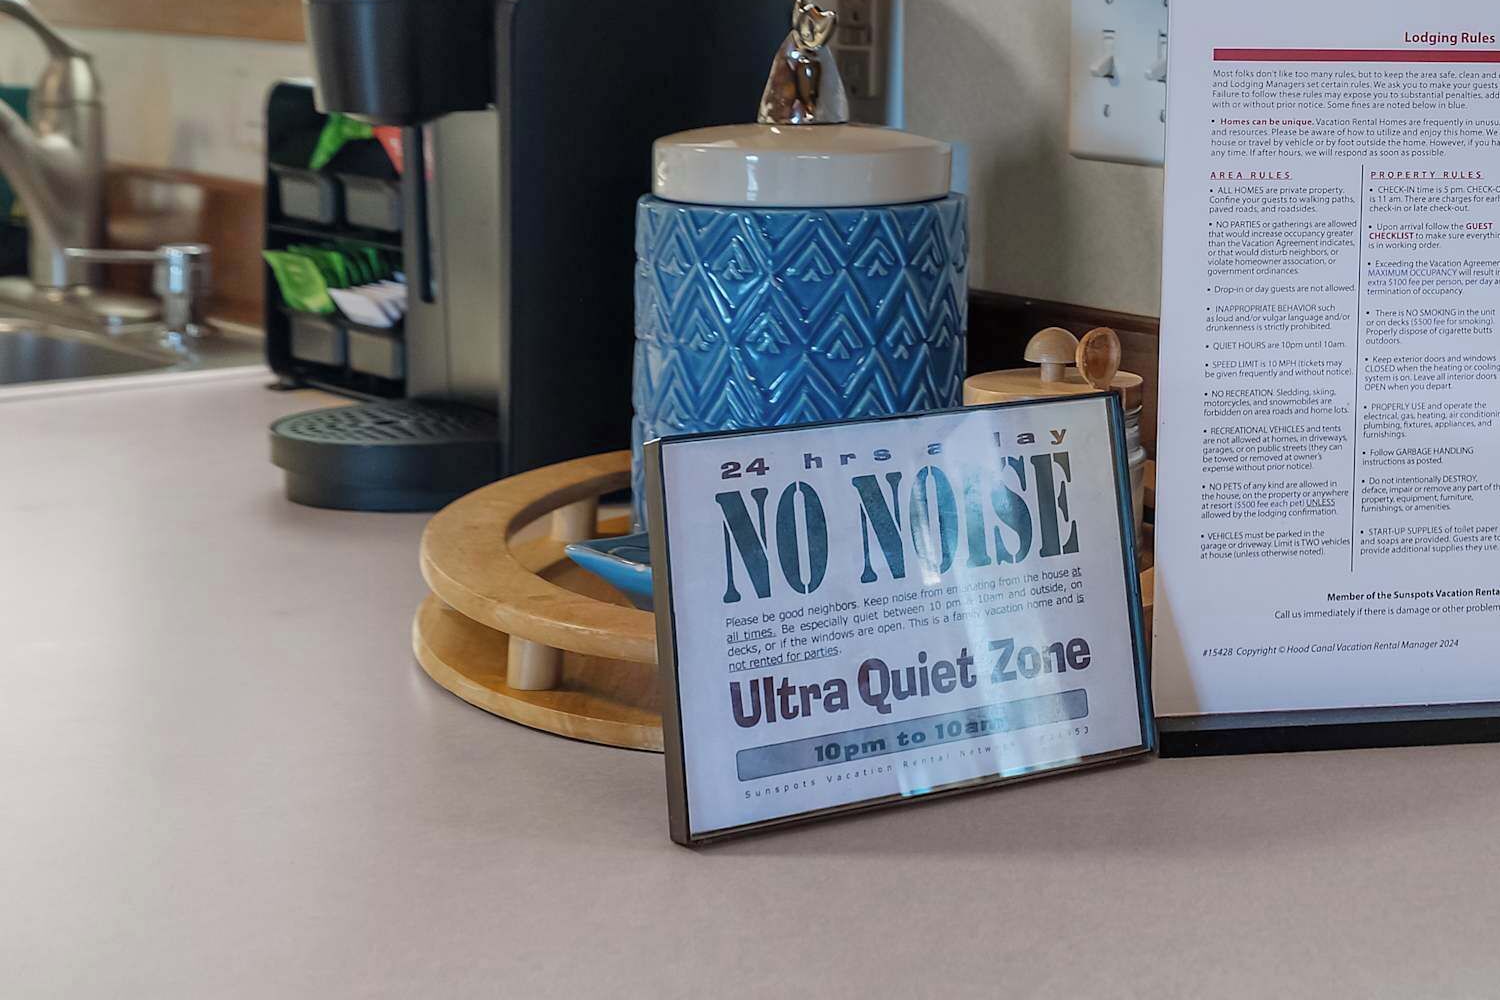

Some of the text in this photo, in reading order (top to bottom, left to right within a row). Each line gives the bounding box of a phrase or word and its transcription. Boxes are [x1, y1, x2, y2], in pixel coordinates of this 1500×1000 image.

[1404, 31, 1496, 46] Lodging Rules
[1220, 118, 1314, 128] Homes can be unique.
[1210, 171, 1291, 179] AREA RULES
[1370, 171, 1482, 179] PROPERTY RULES
[1217, 186, 1232, 195] ALL
[1234, 186, 1264, 195] HOMES
[1265, 187, 1278, 195] are
[1279, 186, 1308, 196] private
[721, 457, 769, 479] 24
[803, 449, 892, 469] hrs
[715, 451, 1080, 603] NO NOISE
[1326, 592, 1365, 601] Member
[1365, 591, 1377, 600] of
[1376, 591, 1393, 599] the
[1393, 590, 1435, 600] Sunspots
[1434, 588, 1475, 598] Vacation
[1273, 609, 1291, 620] Call
[1291, 611, 1302, 619] us
[1302, 607, 1357, 619] immediately
[1356, 607, 1363, 617] if
[1363, 607, 1387, 616] there
[1387, 607, 1395, 615] is
[1395, 606, 1431, 616] damage
[1441, 604, 1465, 615] other
[729, 645, 842, 672] not rented for parties.
[729, 637, 1092, 728] Ultra Quiet Zone
[814, 738, 886, 762] 10pm
[896, 730, 926, 746] to
[744, 778, 816, 799] Sunspots
[826, 765, 893, 784] Vacation
